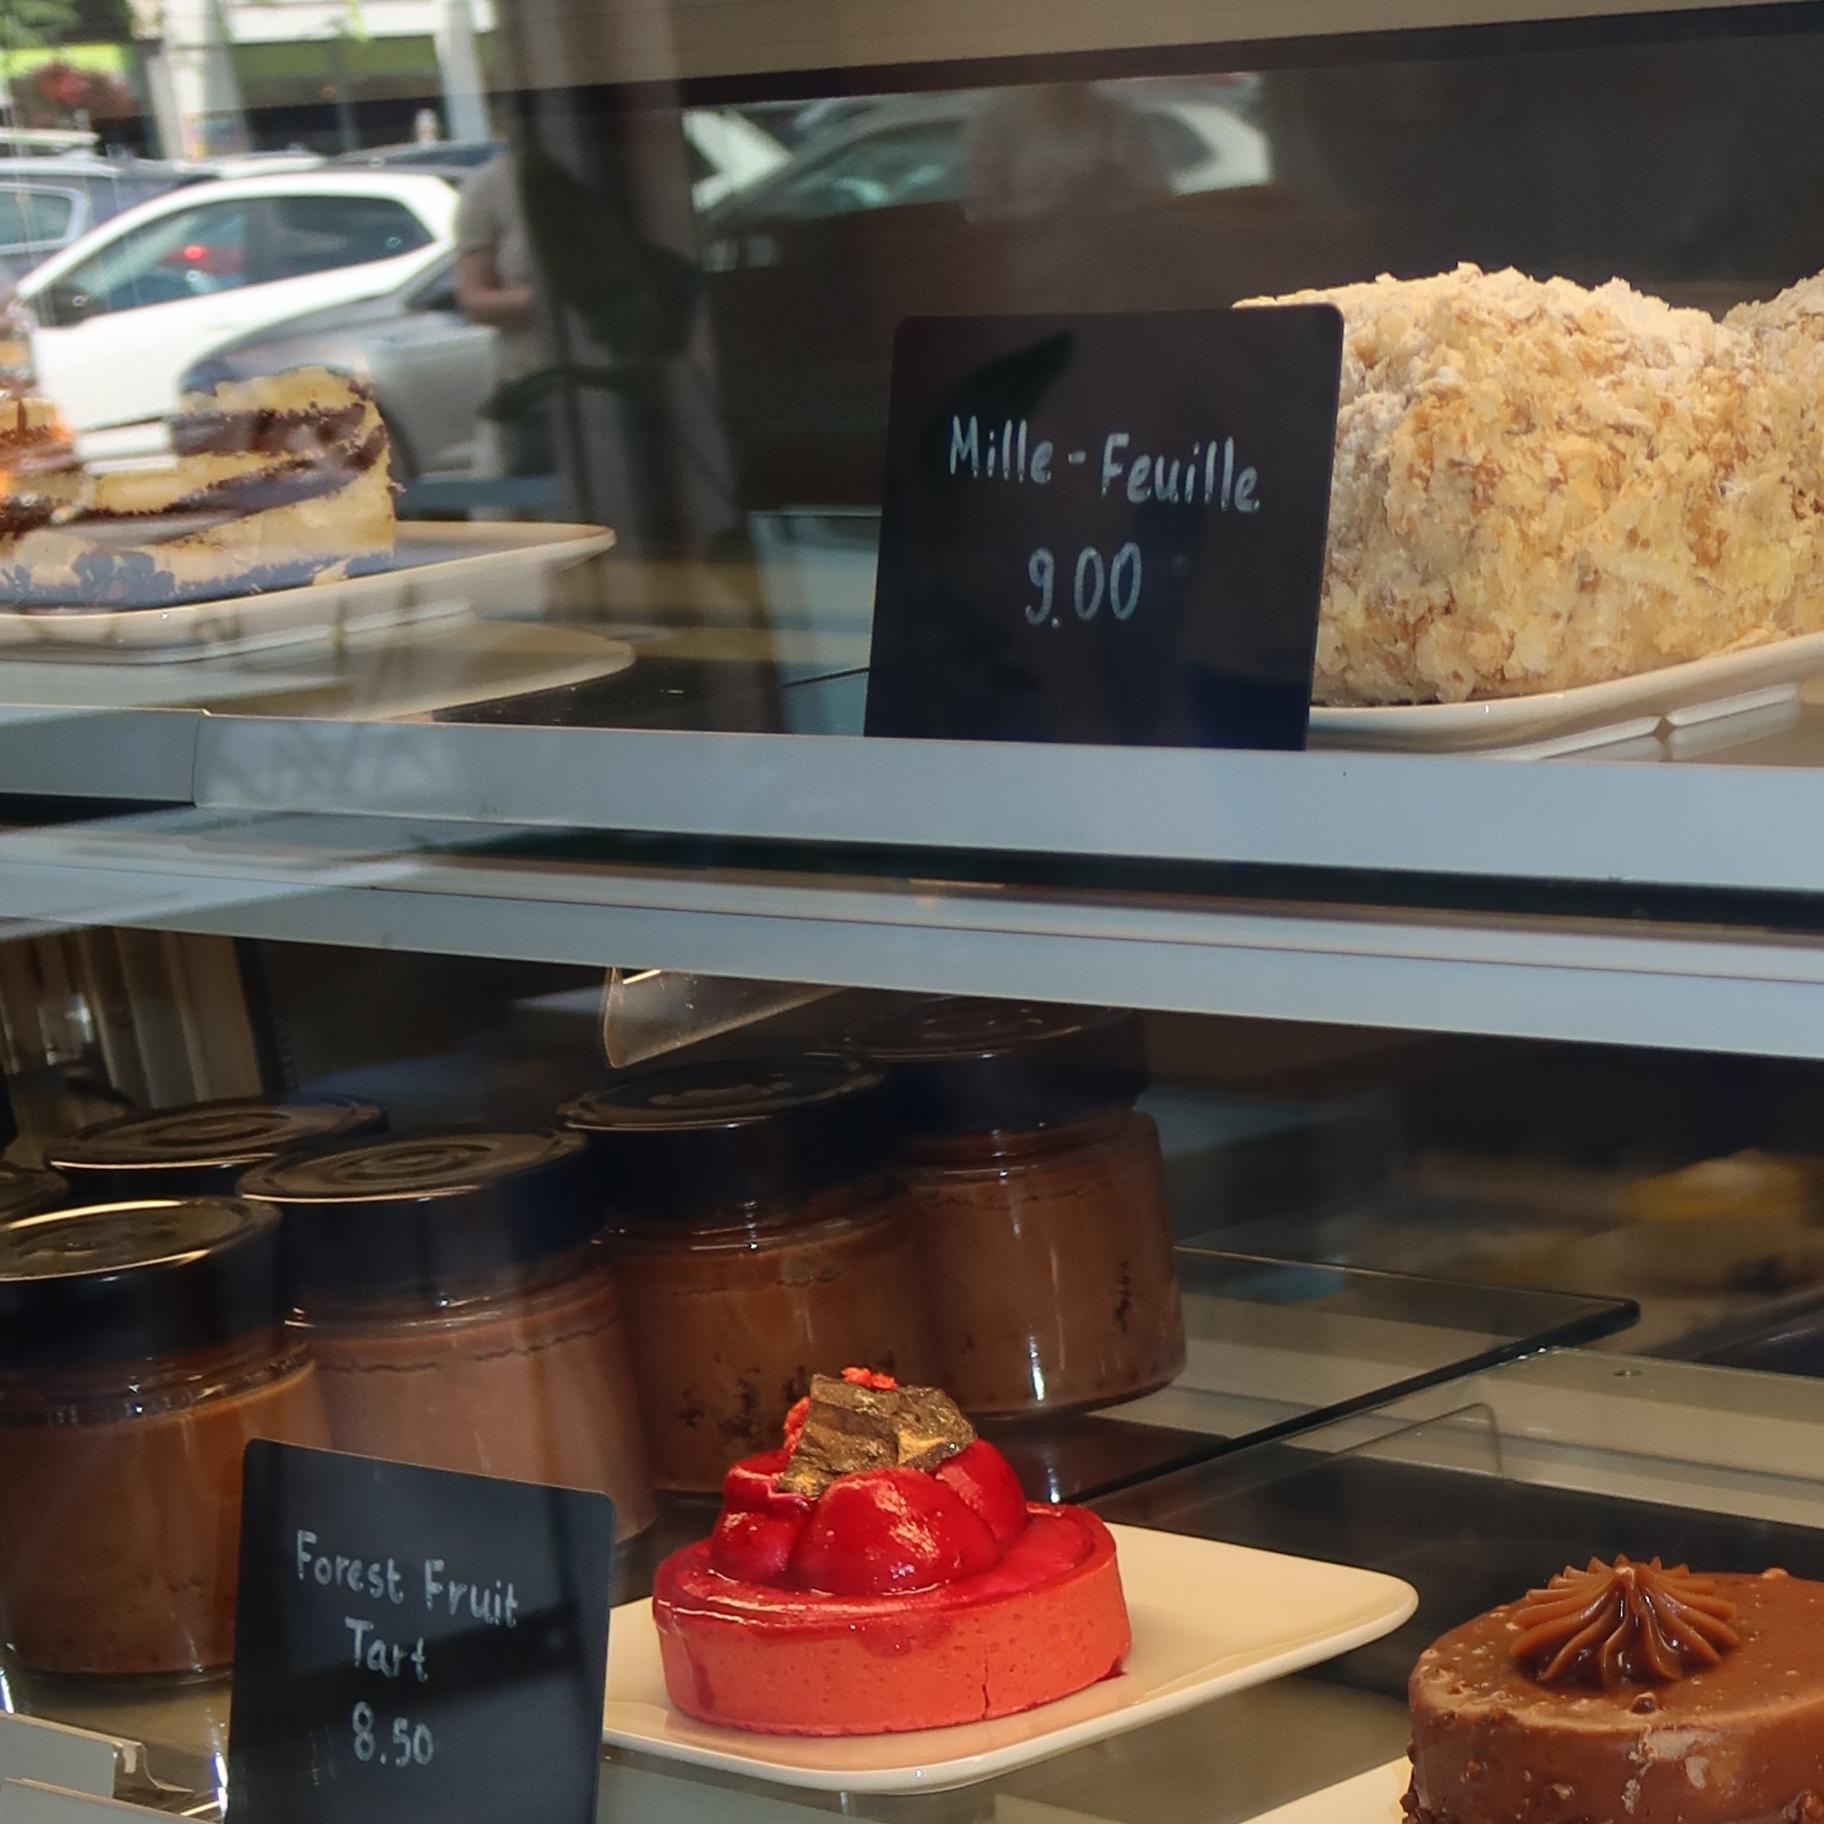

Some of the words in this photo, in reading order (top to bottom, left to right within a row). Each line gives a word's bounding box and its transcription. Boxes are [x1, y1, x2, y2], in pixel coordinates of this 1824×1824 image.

[948, 416, 1262, 512] Mille-Feuille
[1023, 542, 1146, 630] 9.00
[296, 1532, 404, 1605] Forest
[423, 1560, 520, 1631] Fruit
[345, 1618, 429, 1683] Tart
[351, 1702, 436, 1768] 8.50
